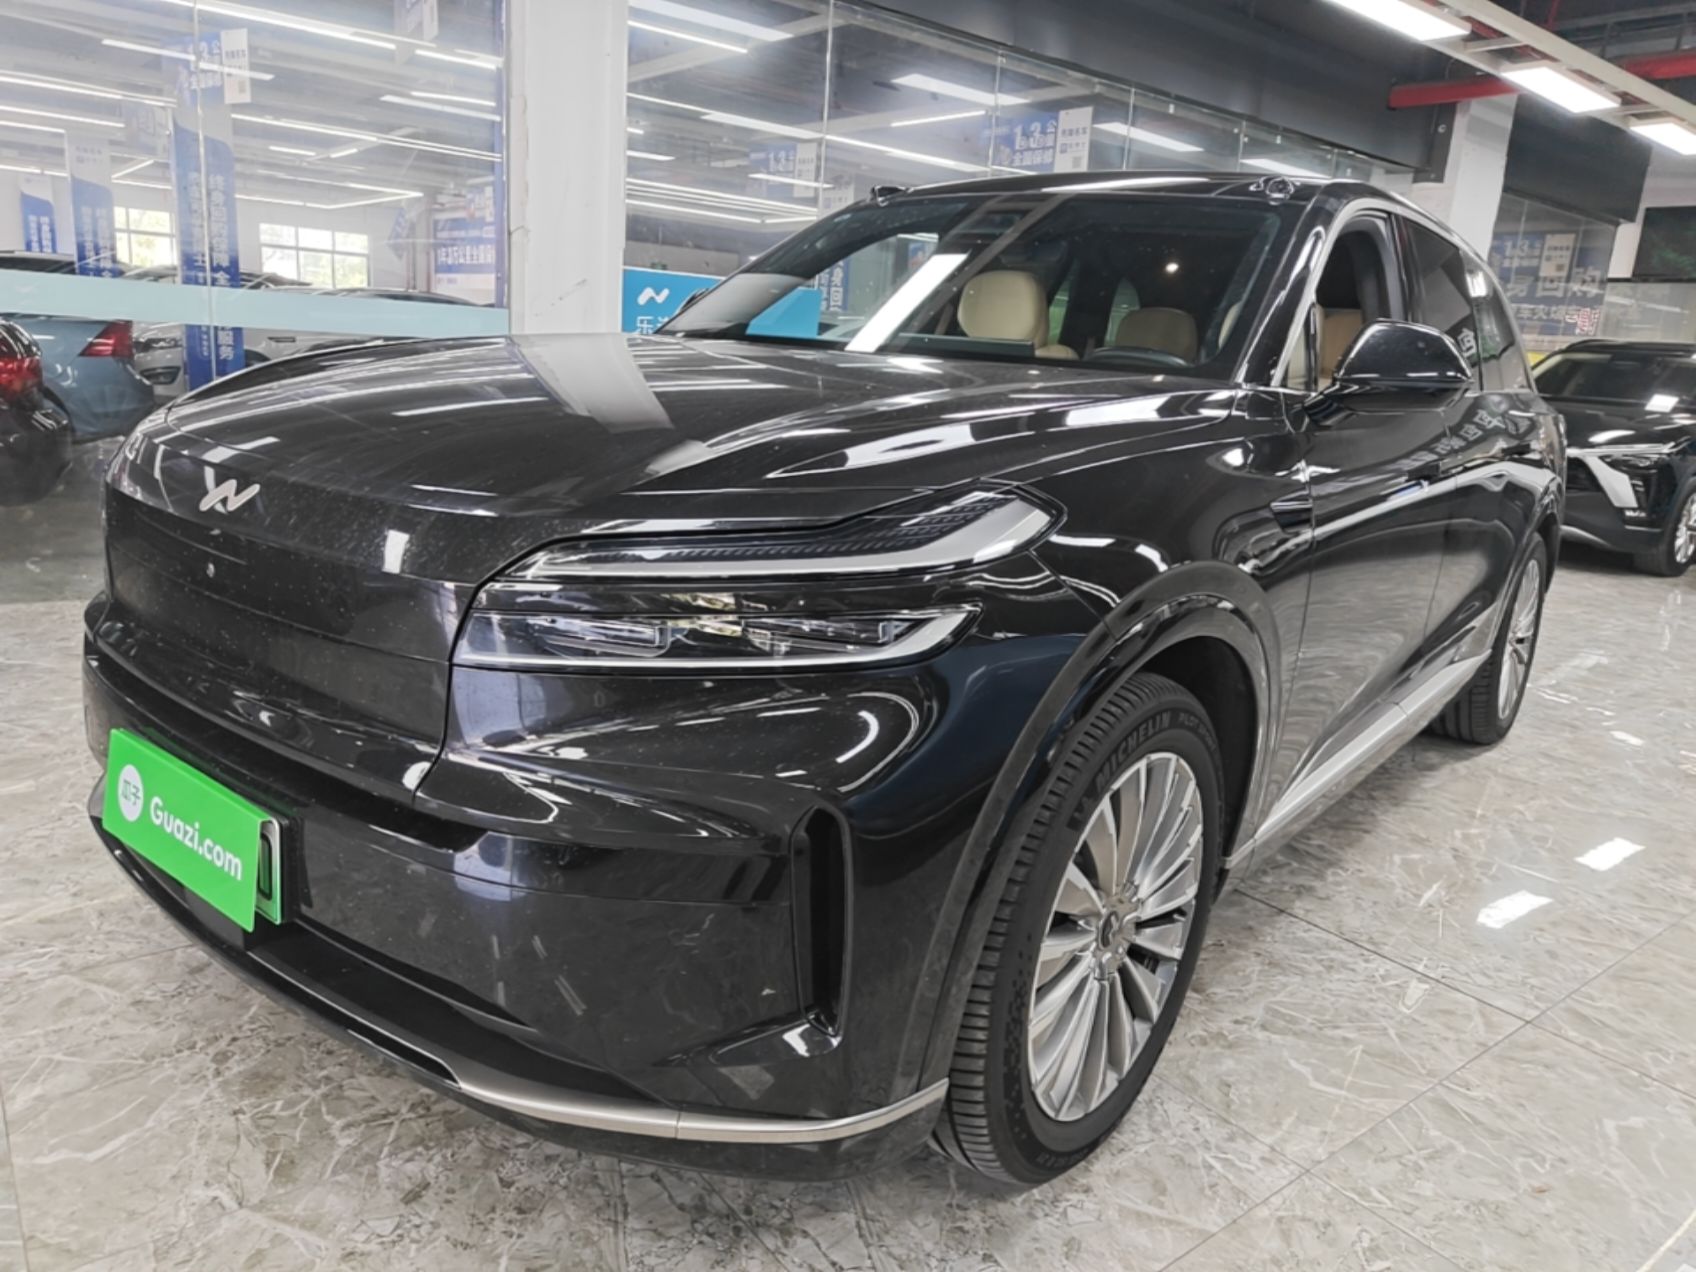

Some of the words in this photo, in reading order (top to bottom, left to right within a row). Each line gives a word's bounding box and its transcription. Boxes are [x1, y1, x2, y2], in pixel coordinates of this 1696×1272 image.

[121, 779, 142, 806] 瓜子
[1096, 711, 1171, 793] MICHELIN
[149, 795, 243, 881] Guazi.com
